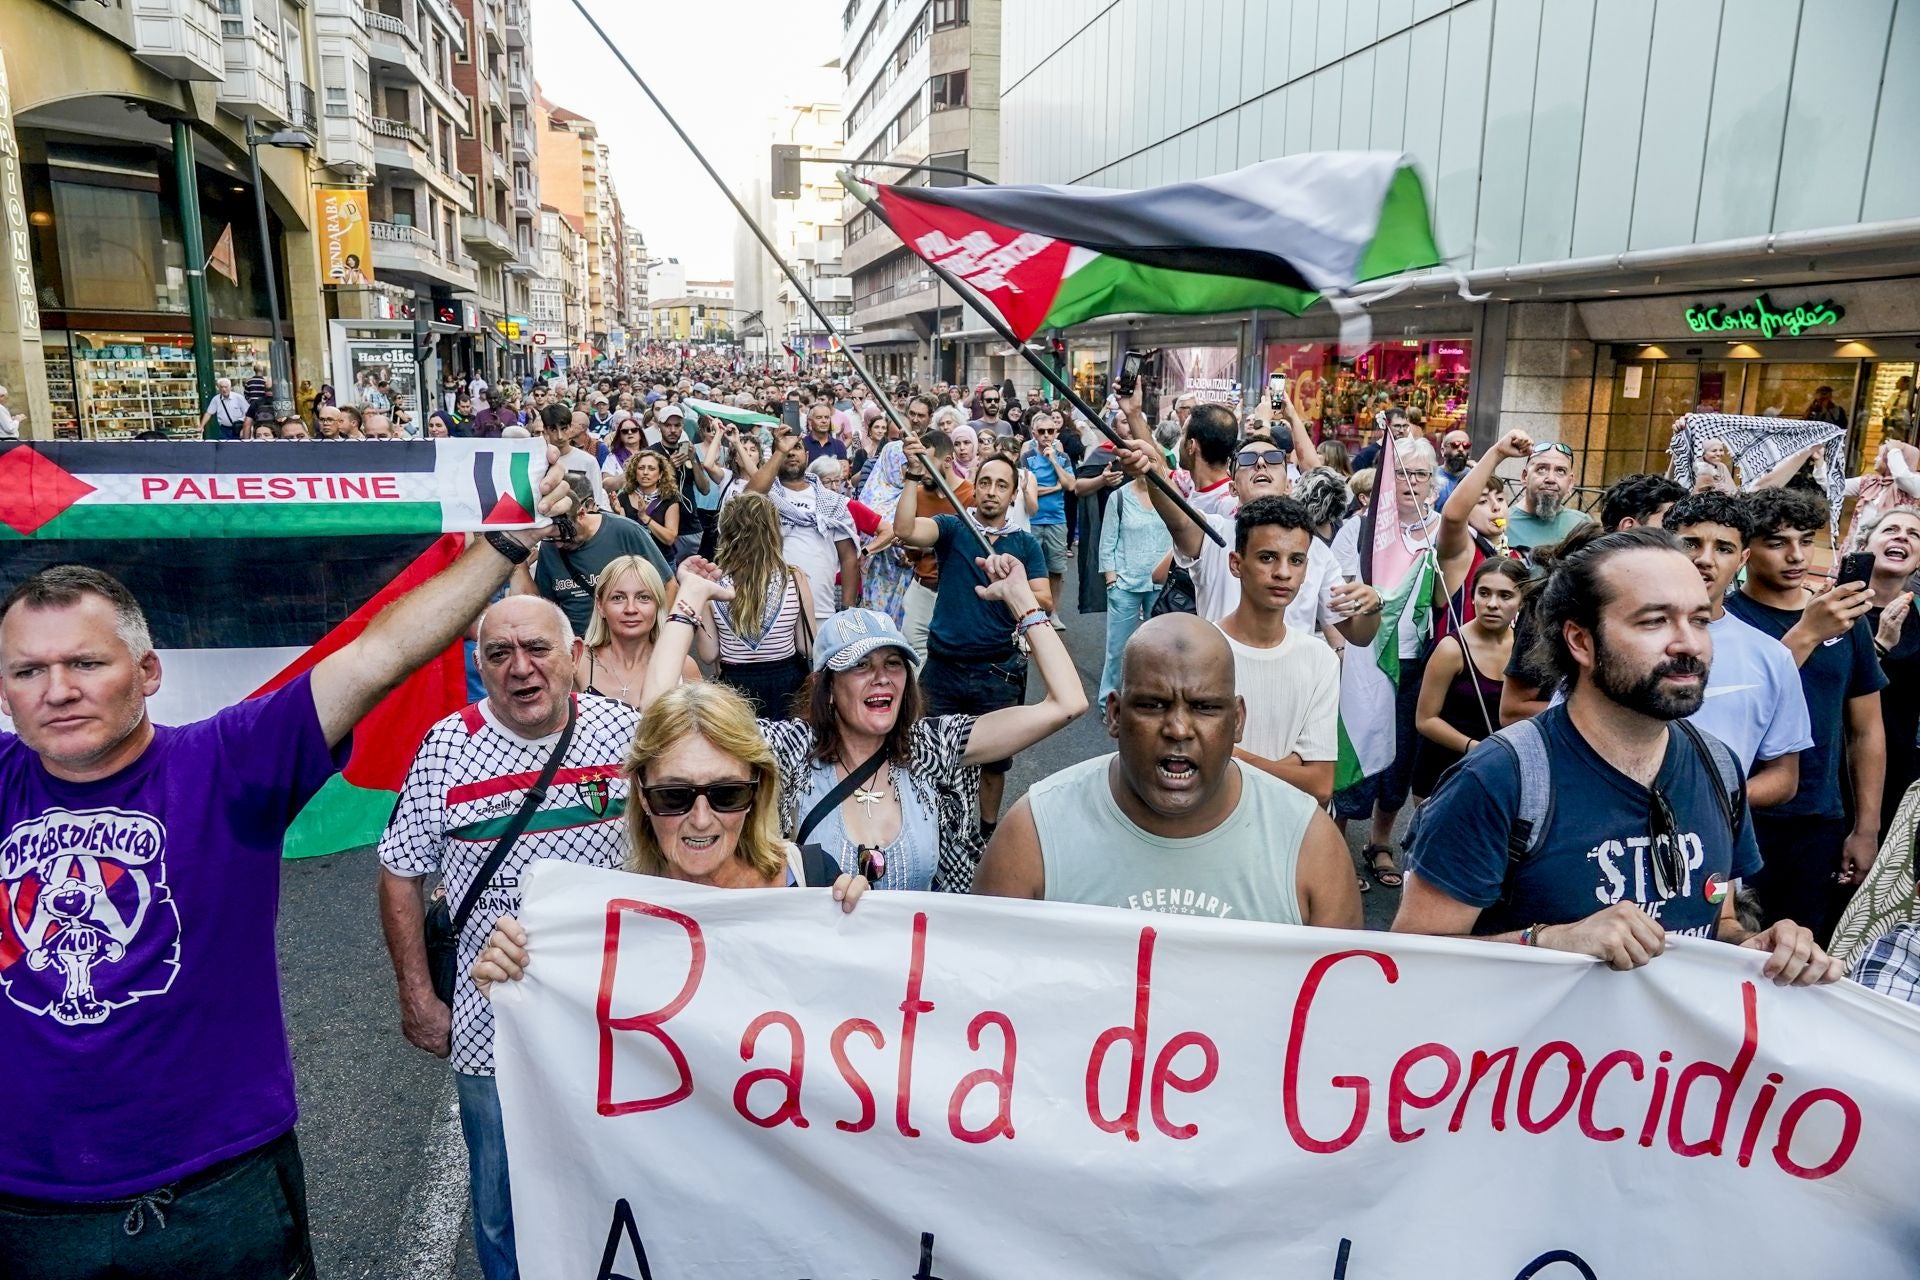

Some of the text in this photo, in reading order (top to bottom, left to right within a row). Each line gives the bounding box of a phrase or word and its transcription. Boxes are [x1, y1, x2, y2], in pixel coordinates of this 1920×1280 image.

[324, 196, 347, 279] DENDARABA
[1686, 298, 1836, 338] El Corte Inglés
[358, 349, 414, 362] Haz clic
[141, 476, 400, 500] PALESTINE
[836, 609, 892, 643] NY
[476, 799, 511, 815] capelli
[1591, 832, 1704, 904] STOP
[478, 896, 522, 911] BANK
[1115, 888, 1233, 919] EGENDARY
[60, 929, 96, 953] NO!
[596, 898, 1862, 1180] Basta de Genocidio
